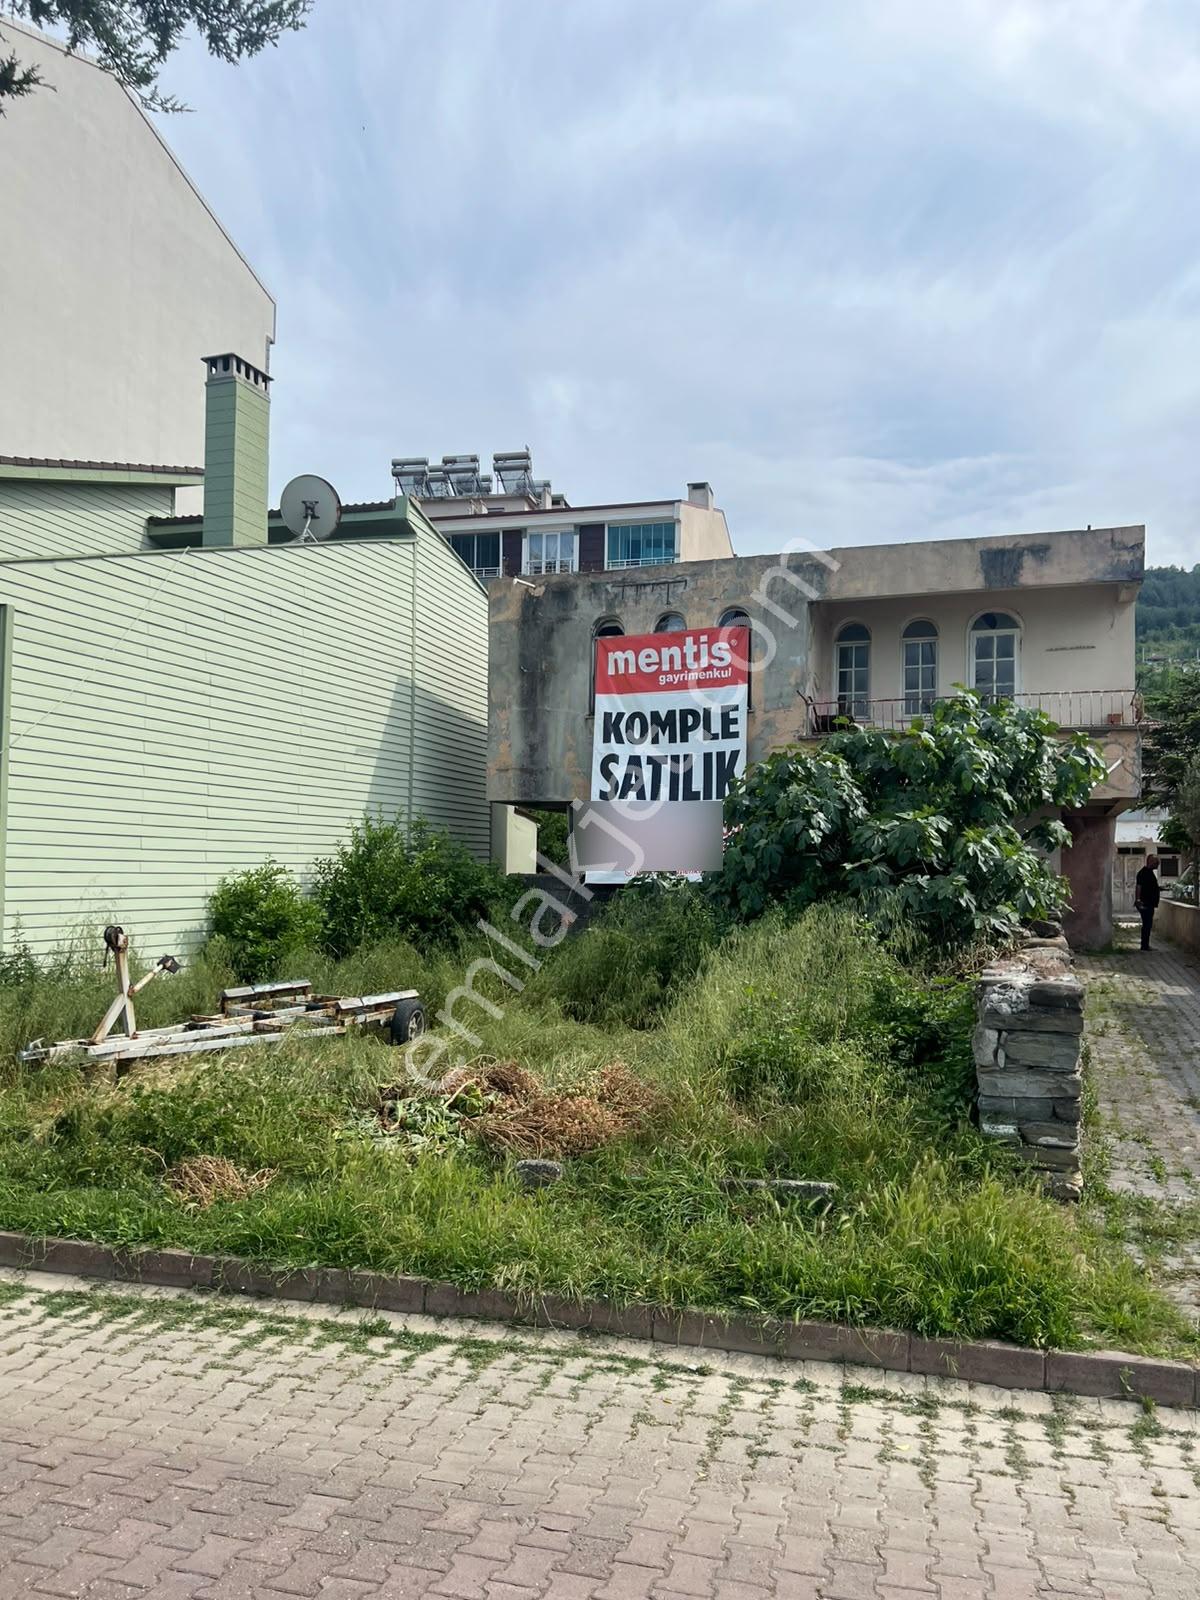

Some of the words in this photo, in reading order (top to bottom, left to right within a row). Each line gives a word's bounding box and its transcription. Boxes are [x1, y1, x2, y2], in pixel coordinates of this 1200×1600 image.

[608, 635, 732, 675] mentis
[658, 668, 732, 685] gayrimenkul
[602, 704, 740, 745] KOMPLE
[599, 749, 741, 802] SATILIK
